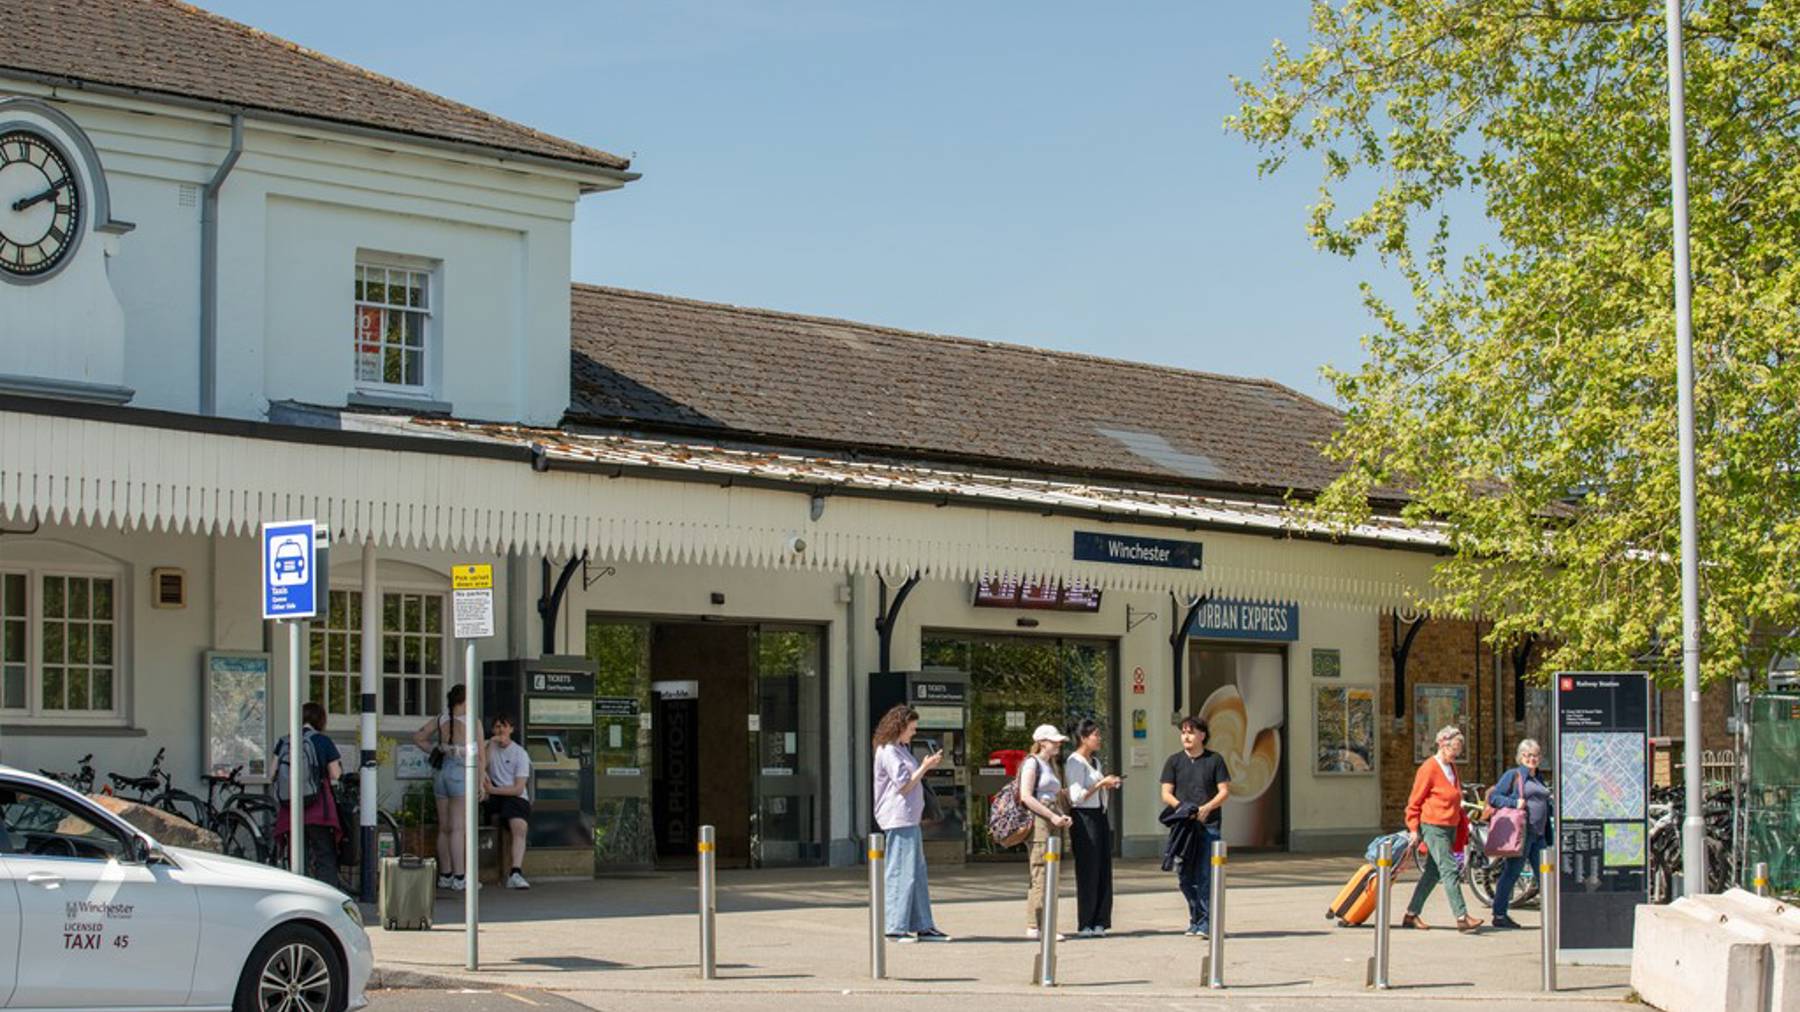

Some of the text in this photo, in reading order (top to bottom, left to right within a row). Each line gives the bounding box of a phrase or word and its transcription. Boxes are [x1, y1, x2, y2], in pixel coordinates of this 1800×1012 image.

[1108, 540, 1170, 562] Winchester
[1199, 603, 1288, 632] URBAN EXPRESS
[547, 674, 572, 683] TICKETS
[1576, 680, 1620, 689] Railway Station
[667, 713, 685, 813] PHOTOS
[667, 818, 685, 844] ID
[78, 901, 135, 914] Winchester
[64, 923, 103, 932] LICENSED
[63, 934, 130, 950] TAXI 45
